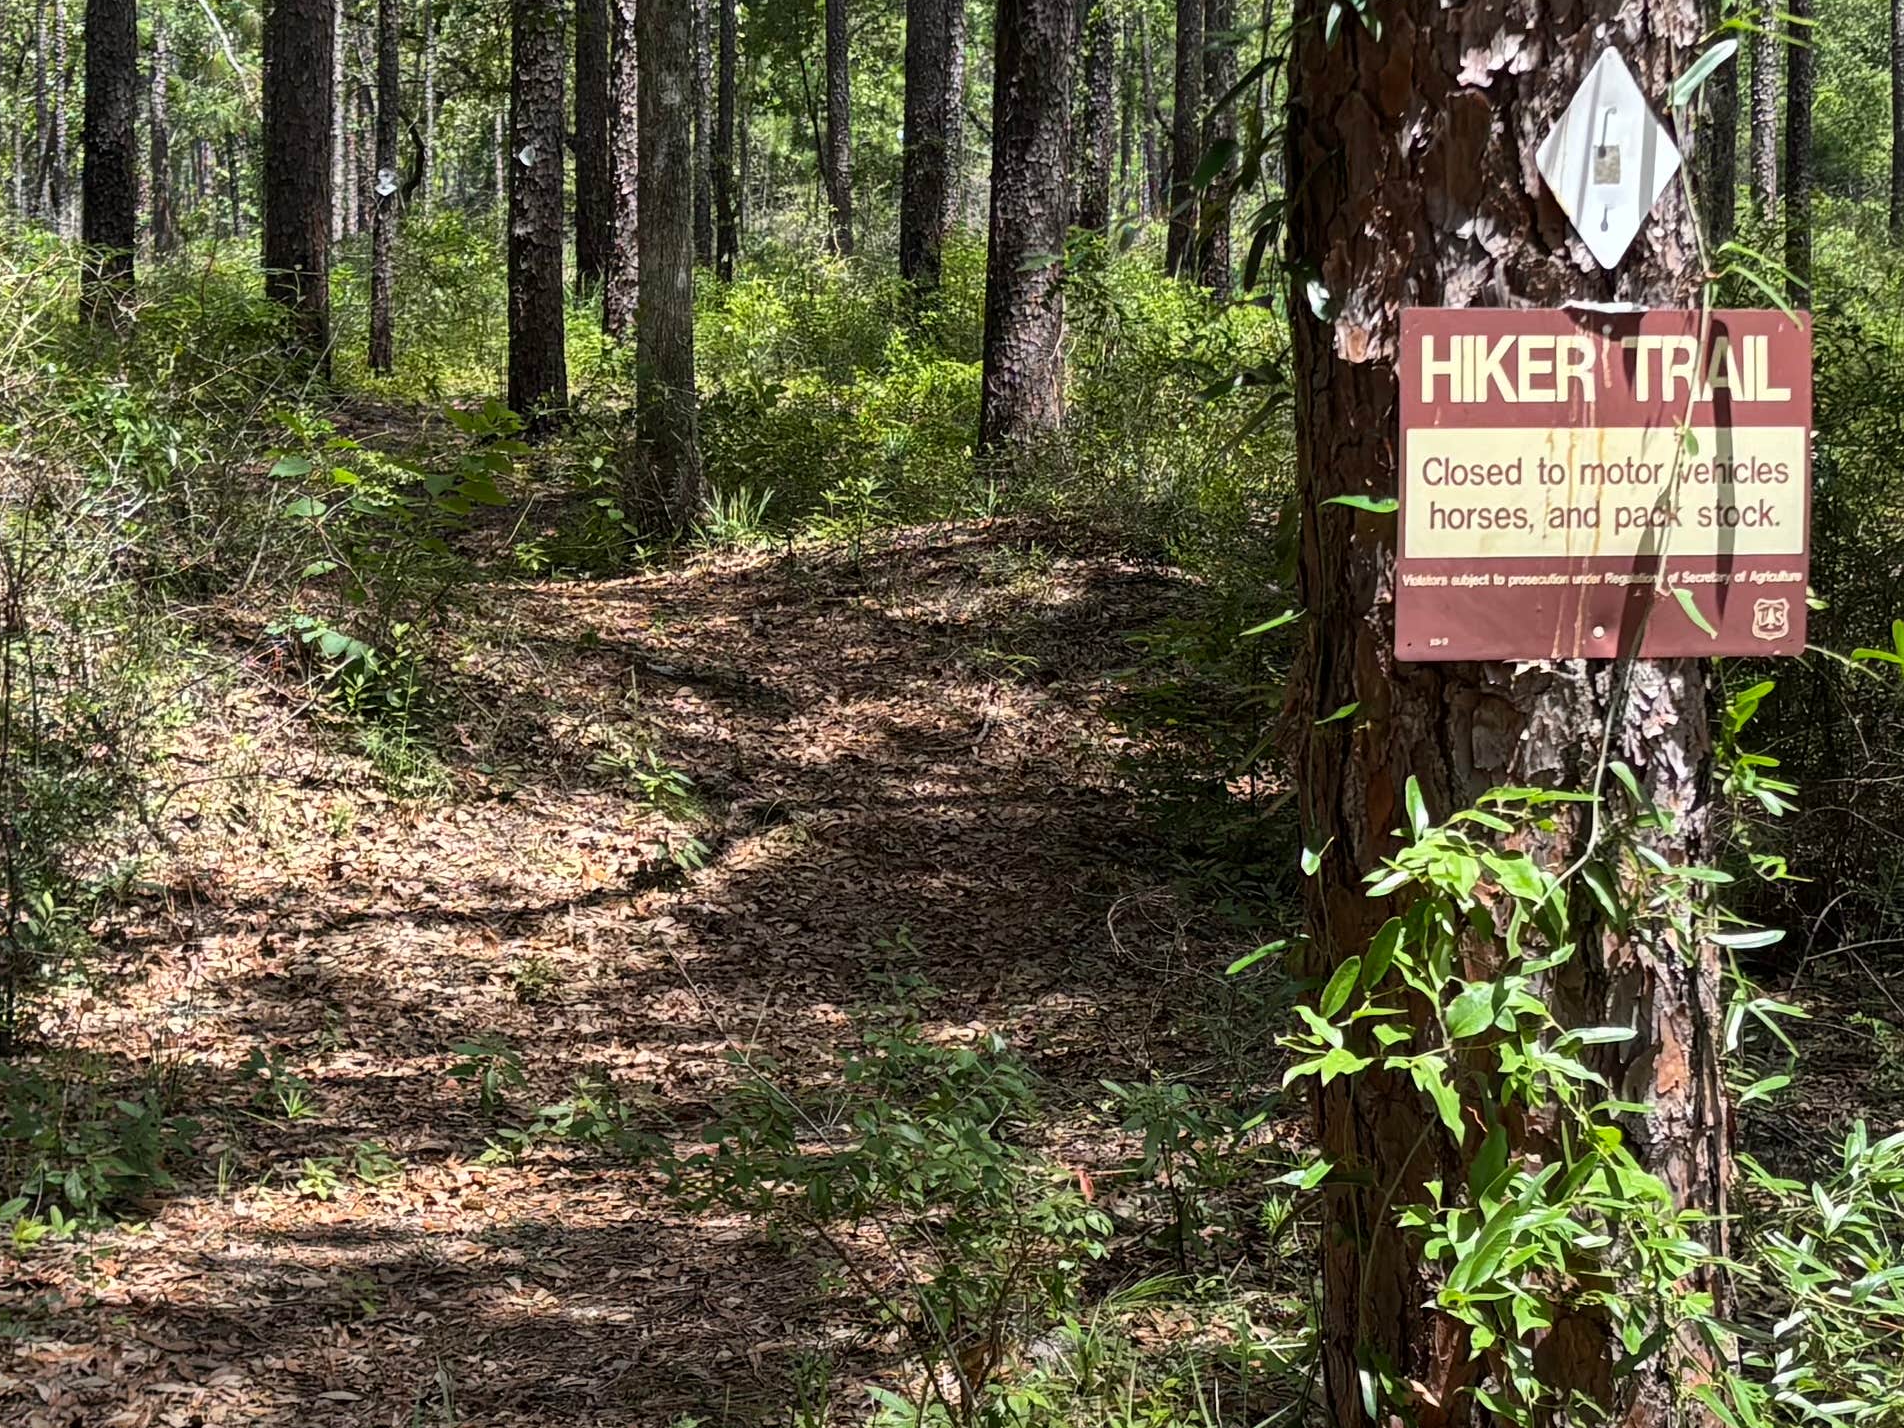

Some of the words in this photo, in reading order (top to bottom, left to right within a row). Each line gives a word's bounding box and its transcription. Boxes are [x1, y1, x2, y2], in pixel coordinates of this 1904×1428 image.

[1421, 335, 1596, 403] HIKER
[1622, 335, 1791, 402] TRAIL
[1423, 457, 1522, 486] Closed
[1538, 458, 1565, 484] to
[1579, 458, 1664, 485] motor
[1679, 456, 1789, 484] vehicles
[1429, 501, 1534, 533] horses,
[1548, 502, 1600, 528] and
[1615, 500, 1683, 533] pack
[1697, 498, 1781, 528] stock.
[1402, 574, 1448, 587] Violators
[1451, 573, 1490, 587] subject
[1494, 573, 1505, 586] to
[1508, 573, 1569, 588] prosecution
[1572, 572, 1602, 585] under
[1734, 570, 1746, 583] of
[1749, 570, 1802, 584] Agriculture
